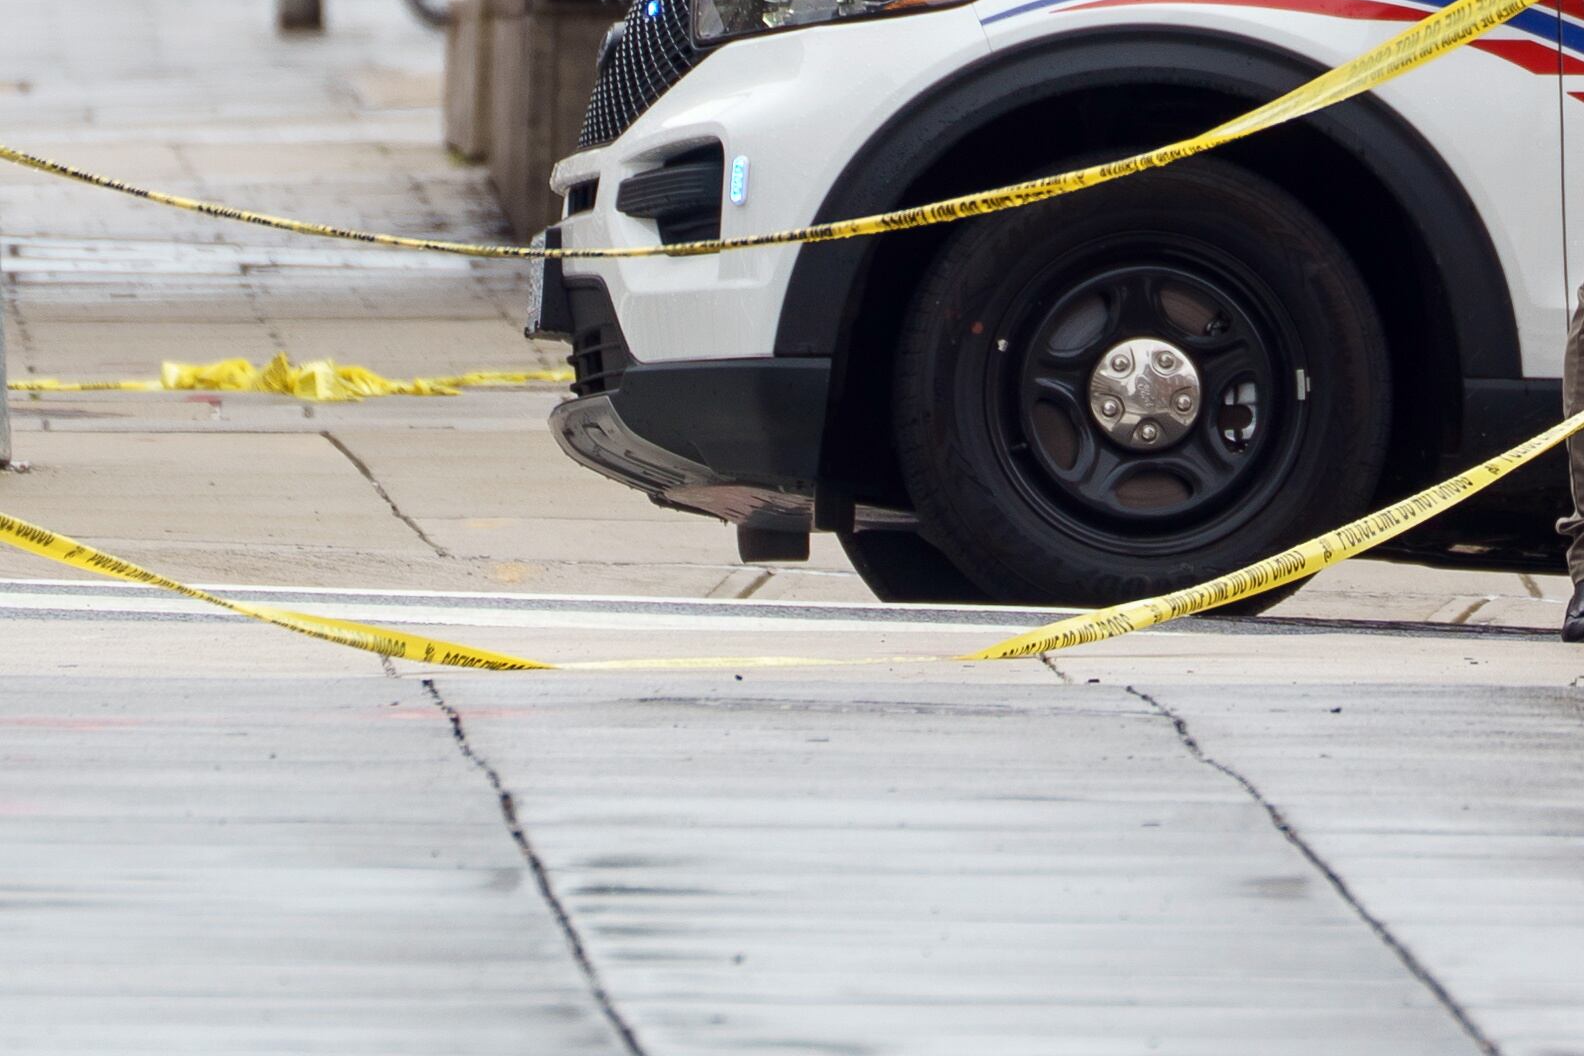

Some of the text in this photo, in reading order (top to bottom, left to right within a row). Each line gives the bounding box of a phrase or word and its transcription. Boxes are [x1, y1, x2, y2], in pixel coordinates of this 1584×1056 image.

[1334, 516, 1377, 551] POLICE
[1369, 505, 1402, 534] LINE
[1394, 499, 1417, 522] DO
[1409, 489, 1439, 514] NOT
[1163, 587, 1209, 619] POLICE
[1200, 576, 1231, 607] LINE
[1225, 570, 1249, 597] DO
[1241, 562, 1272, 591] NOT
[1263, 546, 1309, 582] CROSS
[1074, 622, 1099, 646] NOT
[1093, 609, 1135, 642] CROSS
